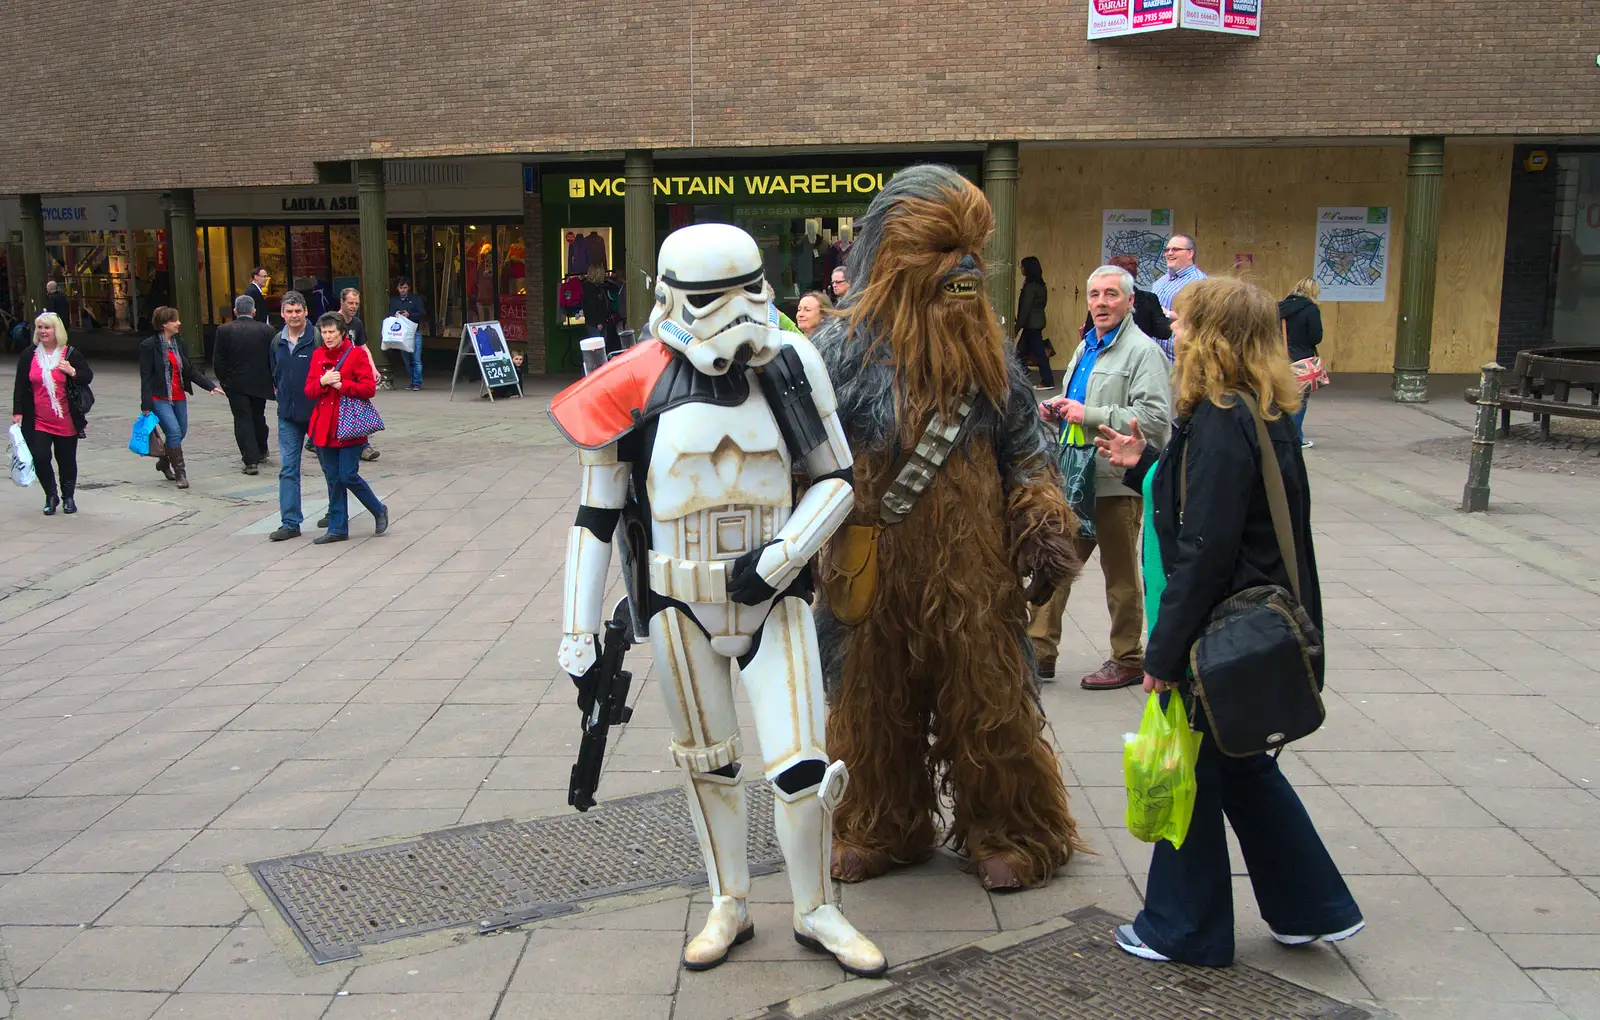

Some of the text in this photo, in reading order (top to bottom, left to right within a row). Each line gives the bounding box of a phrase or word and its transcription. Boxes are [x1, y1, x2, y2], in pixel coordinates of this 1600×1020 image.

[1133, 10, 1173, 24] 020 7935 5000
[1224, 14, 1234, 24] 020
[1234, 16, 1244, 24] 7935
[590, 172, 893, 196] MONTAIN WAREHOU
[281, 196, 358, 210] LAURA ASH
[837, 206, 868, 214] SERV
[74, 206, 88, 220] UK
[500, 304, 527, 319] SALE
